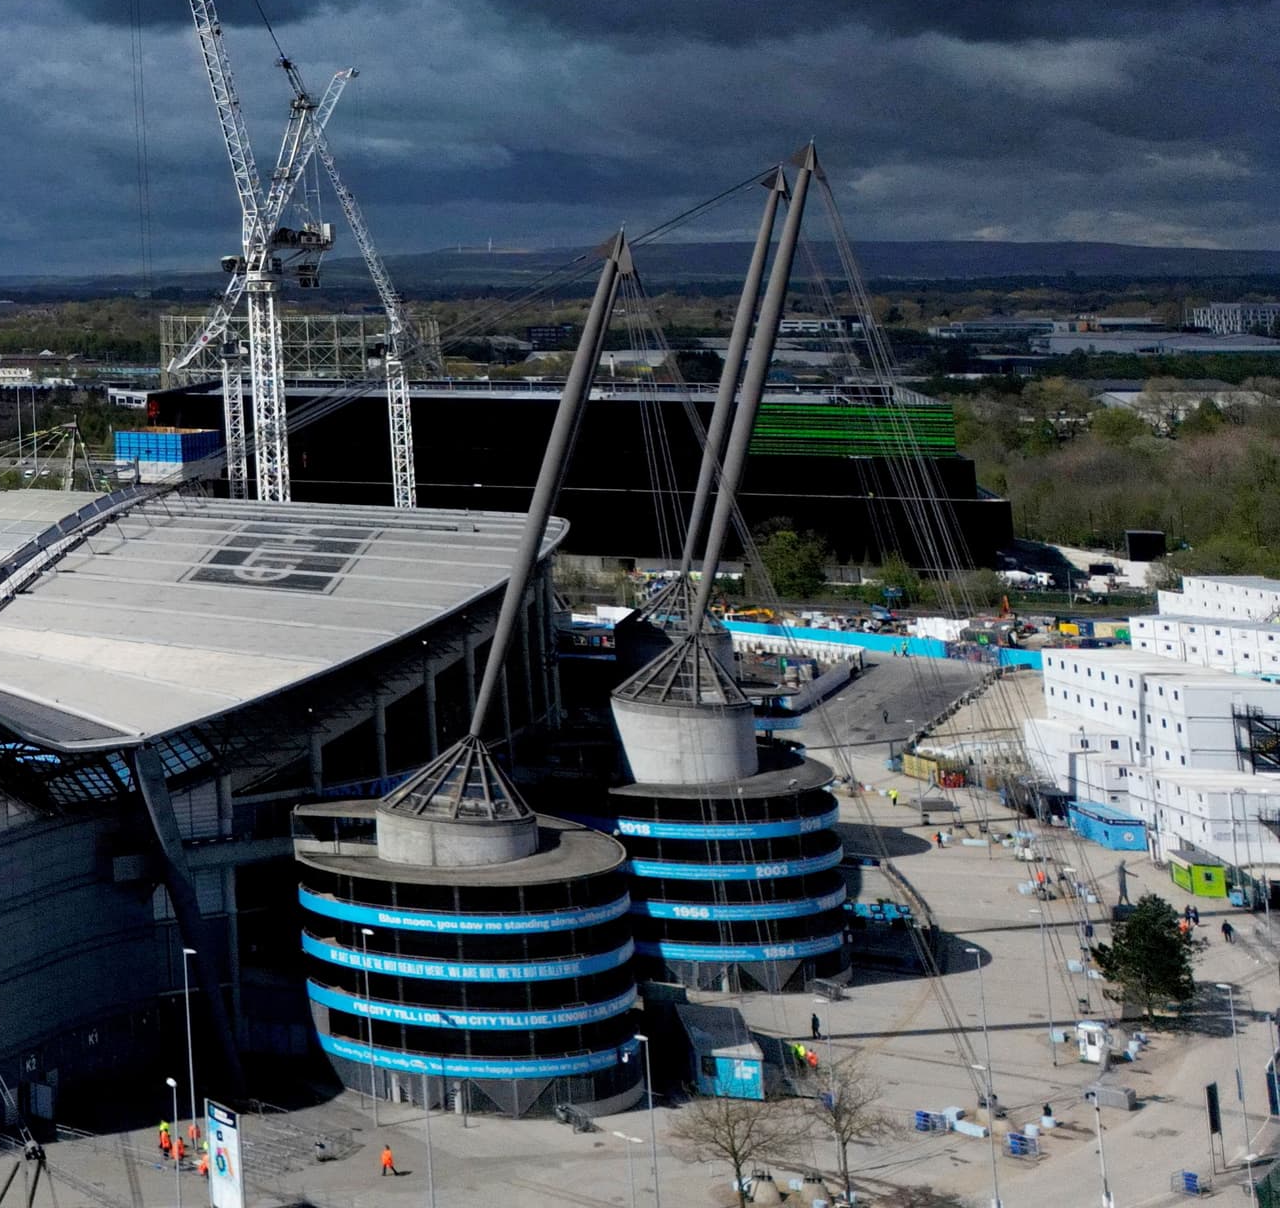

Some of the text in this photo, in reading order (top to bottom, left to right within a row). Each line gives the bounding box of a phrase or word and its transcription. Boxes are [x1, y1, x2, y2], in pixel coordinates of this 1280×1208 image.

[619, 822, 651, 835] 2018
[755, 865, 789, 878] 2003
[672, 907, 710, 919] 1956
[378, 912, 401, 924] Blue
[437, 920, 458, 931] you
[459, 921, 483, 930] saw
[484, 922, 502, 930] me
[503, 918, 550, 931] standing
[763, 945, 796, 958] 1894
[392, 1009, 417, 1021] TILL
[469, 1016, 497, 1026] CITY
[498, 1016, 524, 1026] TILL
[557, 1012, 589, 1023] KNOW
[26, 1057, 37, 1073] K2
[486, 1065, 513, 1075] happy
